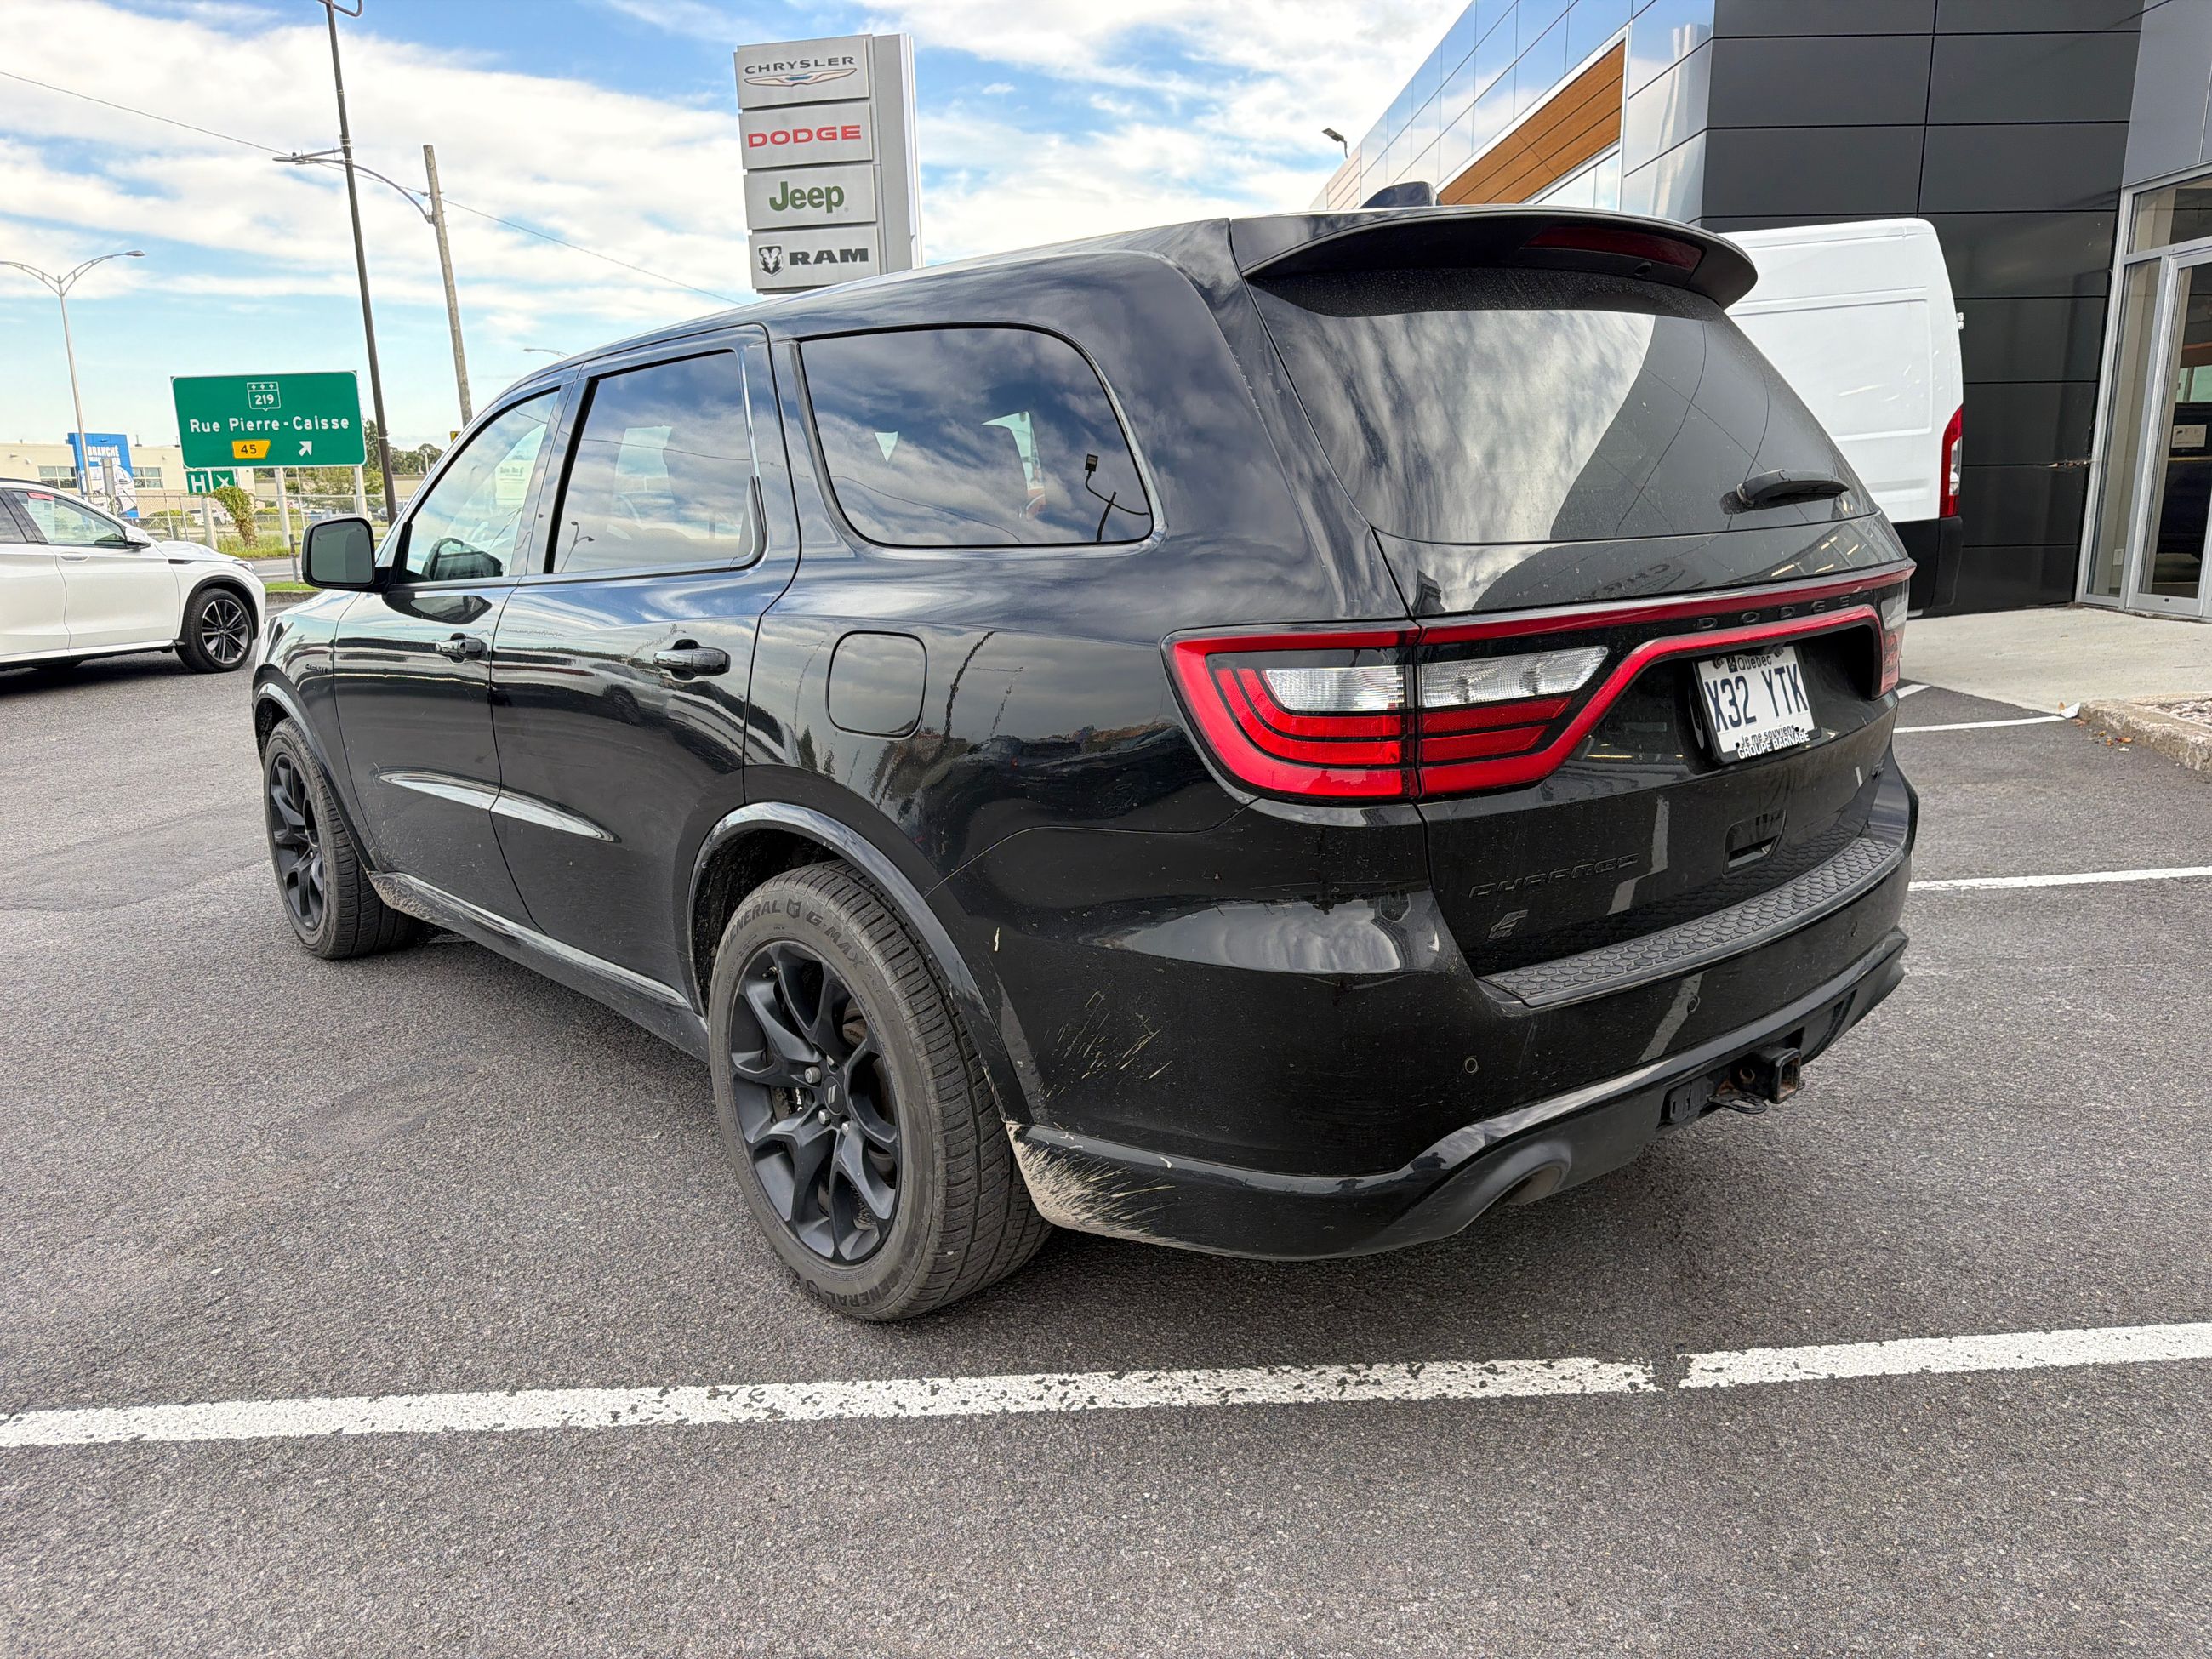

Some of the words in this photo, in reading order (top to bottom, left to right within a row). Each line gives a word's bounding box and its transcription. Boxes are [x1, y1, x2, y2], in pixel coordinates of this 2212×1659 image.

[744, 56, 855, 74] CHRYSLER
[748, 125, 862, 148] DODGE
[769, 181, 845, 213] Jeep
[789, 248, 869, 265] RAM
[254, 394, 275, 405] 219
[190, 419, 220, 433] Rue
[240, 444, 257, 454] 45
[191, 474, 207, 494] H
[1695, 596, 1850, 631] DODGE
[1704, 675, 1757, 733] X32
[1761, 664, 1809, 718] YTK
[1741, 735, 1749, 746] Je
[1751, 733, 1762, 744] me
[1764, 724, 1795, 741] souviens
[1737, 742, 1773, 760] GROUPE
[722, 899, 781, 956] GENERAL
